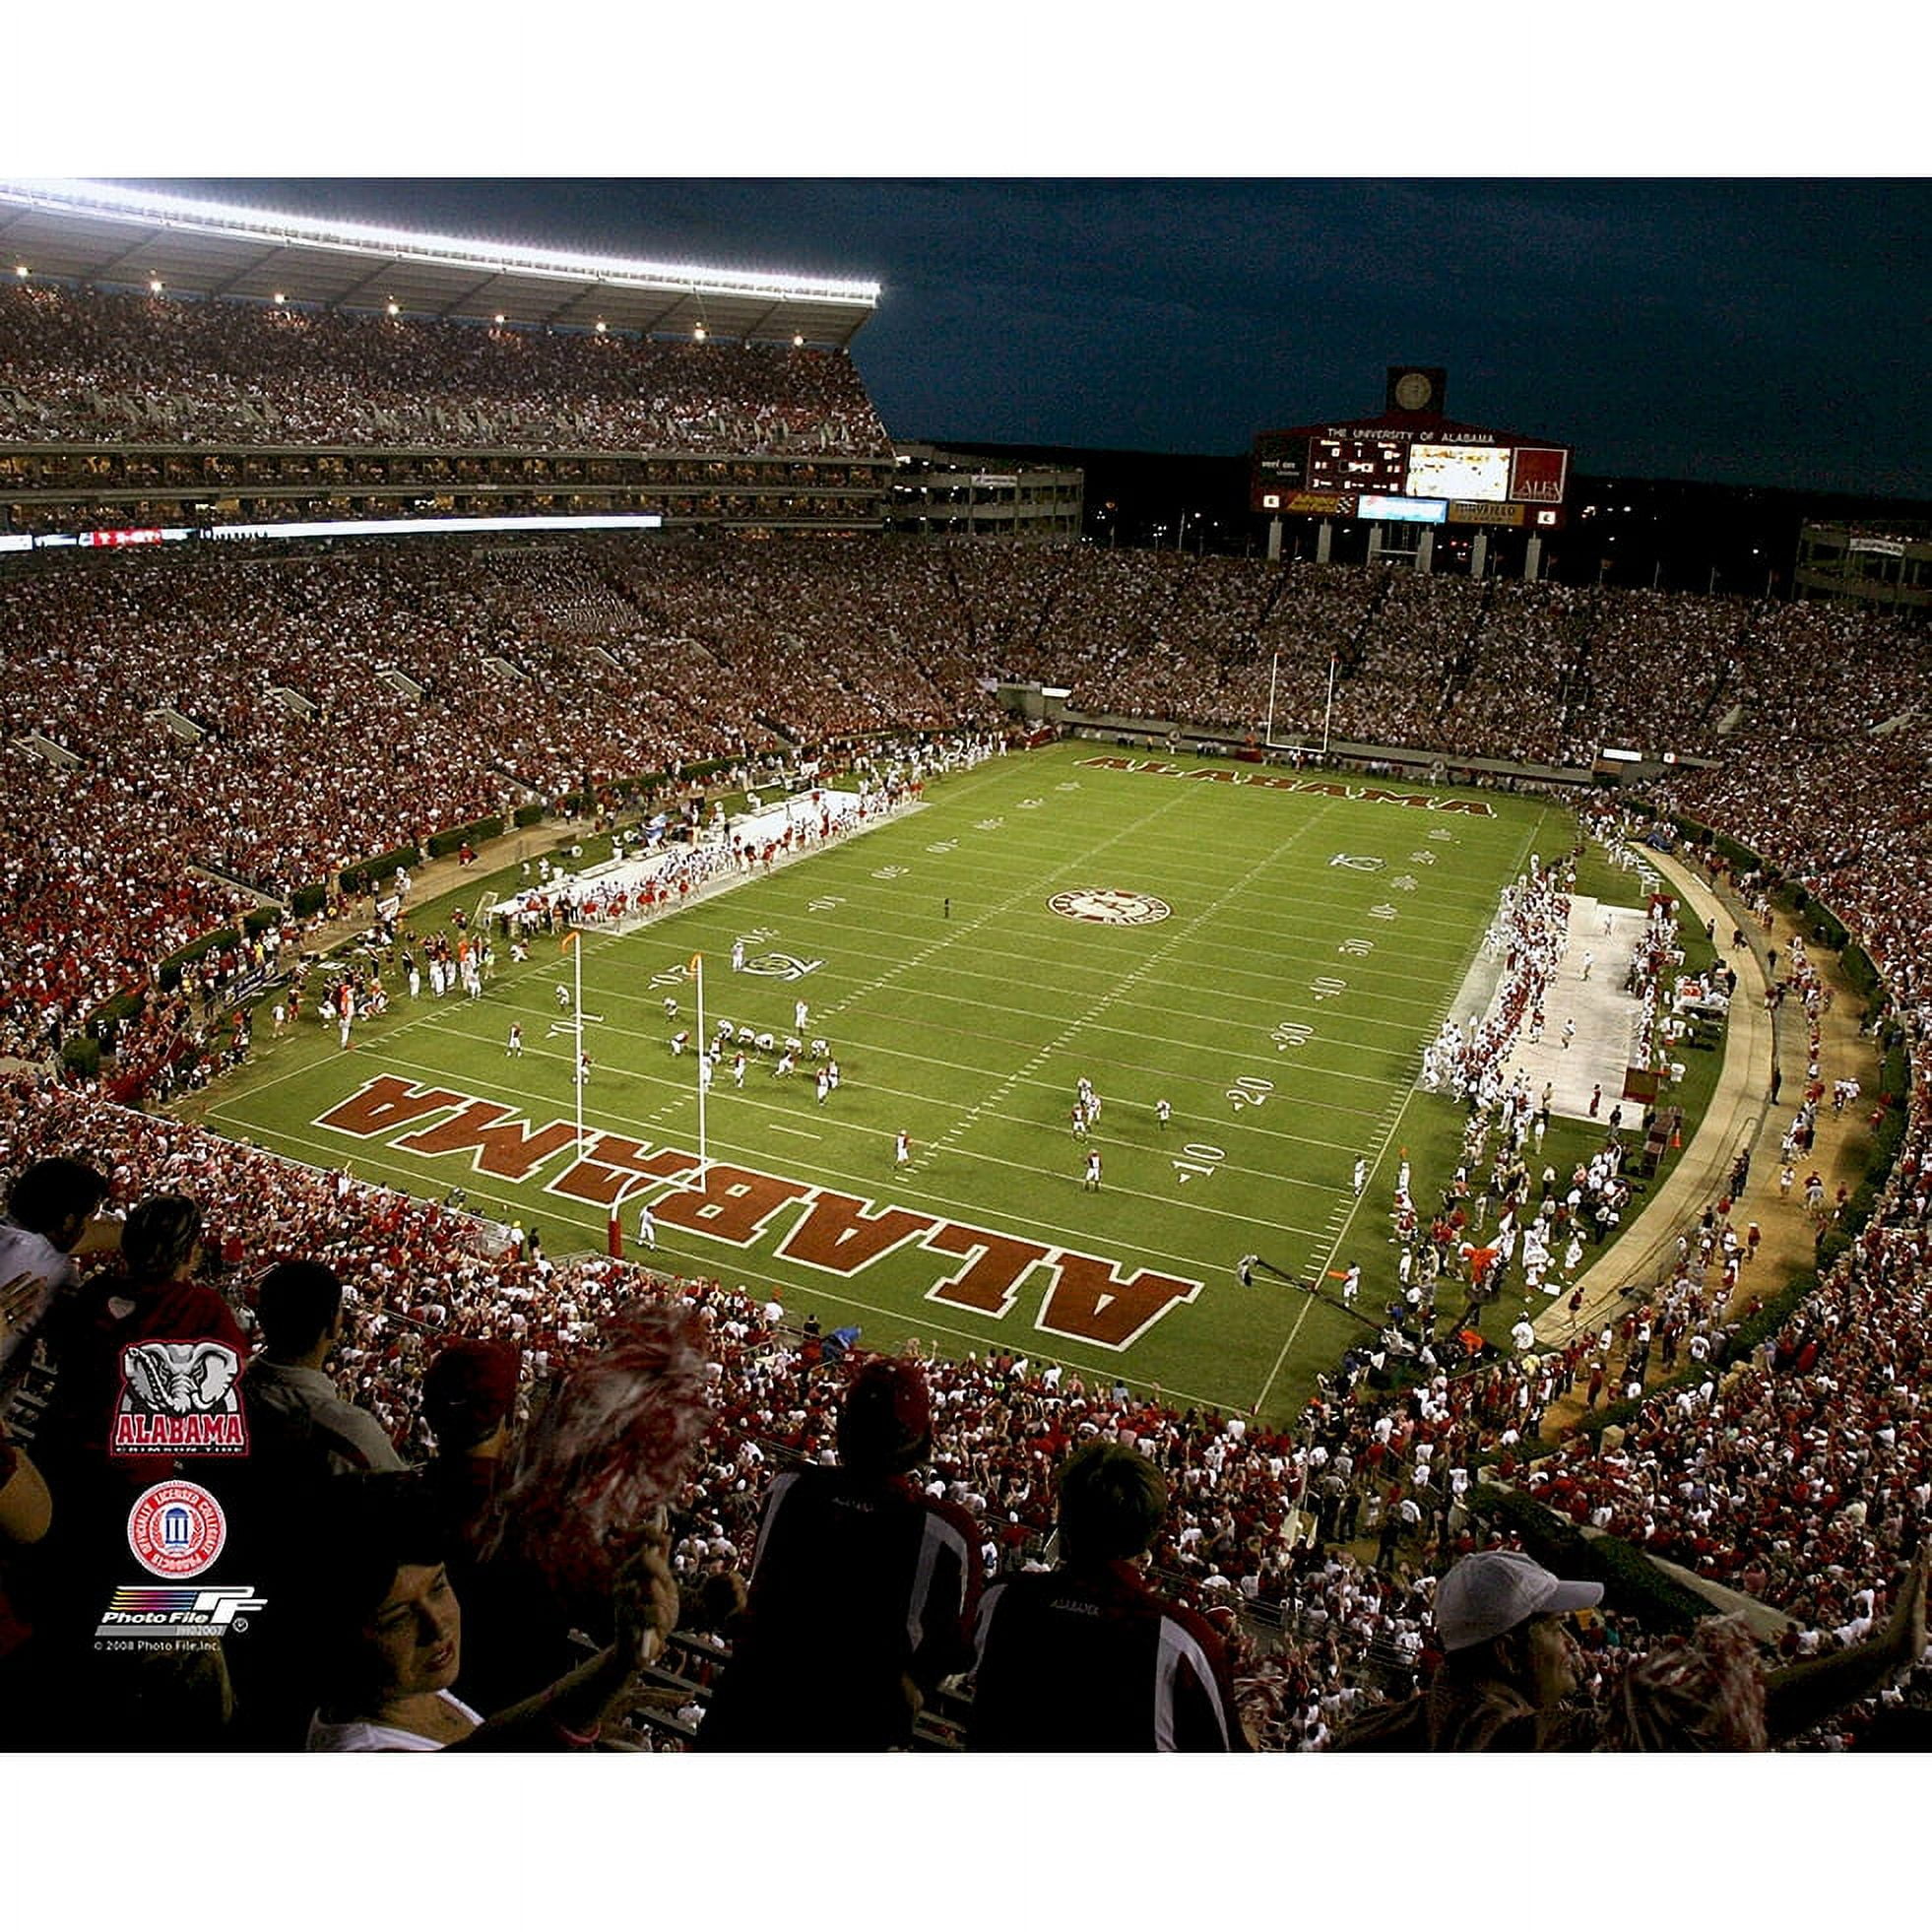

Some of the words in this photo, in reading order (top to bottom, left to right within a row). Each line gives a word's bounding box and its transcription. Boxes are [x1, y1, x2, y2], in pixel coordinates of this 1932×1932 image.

[1327, 428, 1347, 438] THE
[1420, 431, 1434, 442] OF
[1442, 433, 1495, 443] ALABAMA
[1073, 754, 1499, 819] ALABAMA
[1270, 1021, 1314, 1047] 30
[1226, 1075, 1275, 1107] 20
[1172, 1143, 1225, 1177] 10
[311, 1072, 1204, 1353] ALABAMA
